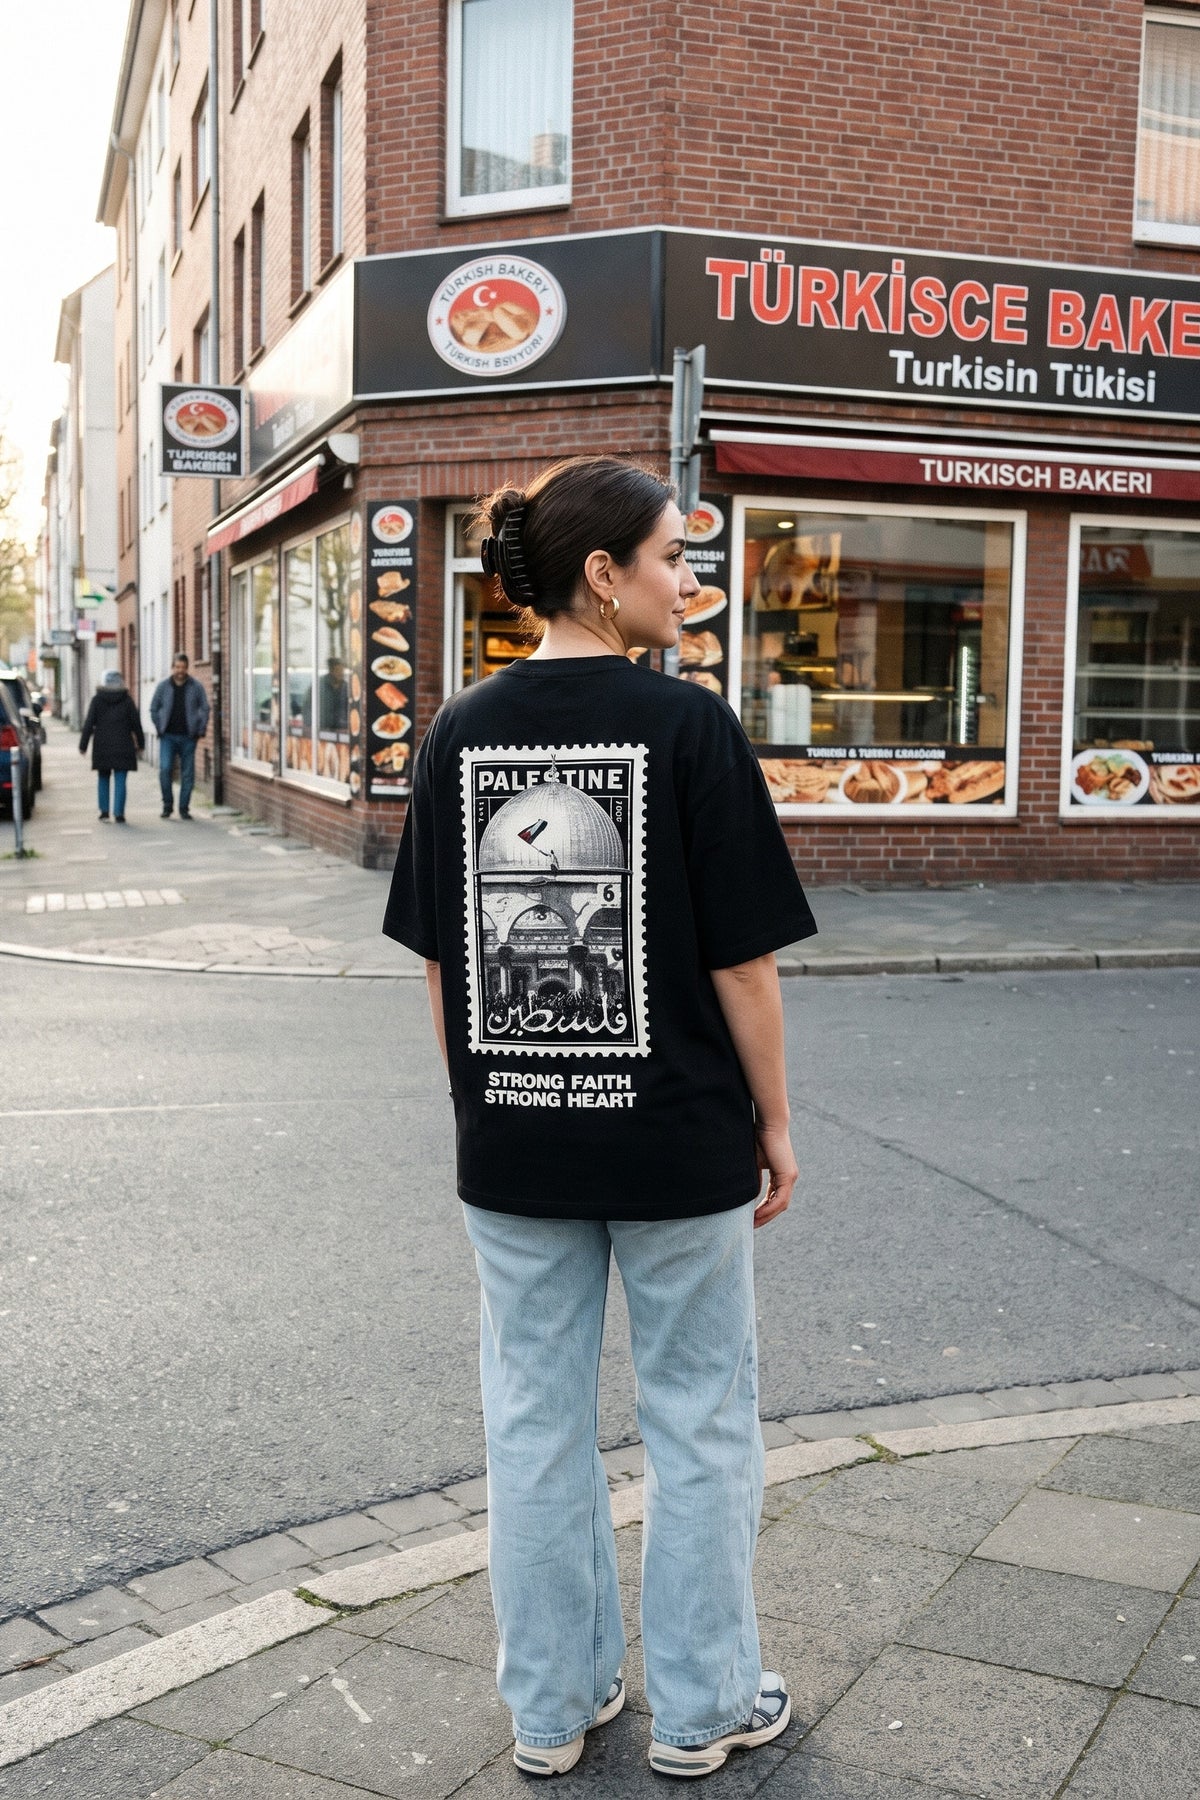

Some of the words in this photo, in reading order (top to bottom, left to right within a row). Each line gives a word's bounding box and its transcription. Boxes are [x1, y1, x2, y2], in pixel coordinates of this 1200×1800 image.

[498, 263, 549, 295] BAKERY
[706, 248, 1028, 345] TÜRKİSCE
[889, 350, 1038, 394] Turkisin
[1050, 362, 1156, 403] Tükisi
[920, 458, 1051, 489] TURKISCH
[1059, 467, 1152, 494] BAKERI
[478, 769, 623, 791] PALESTINE
[487, 992, 628, 1037] فلسطين
[488, 1072, 565, 1090] STRONG
[571, 1074, 632, 1090] FAITH
[484, 1089, 561, 1107] STRONG
[567, 1092, 637, 1108] HEART
